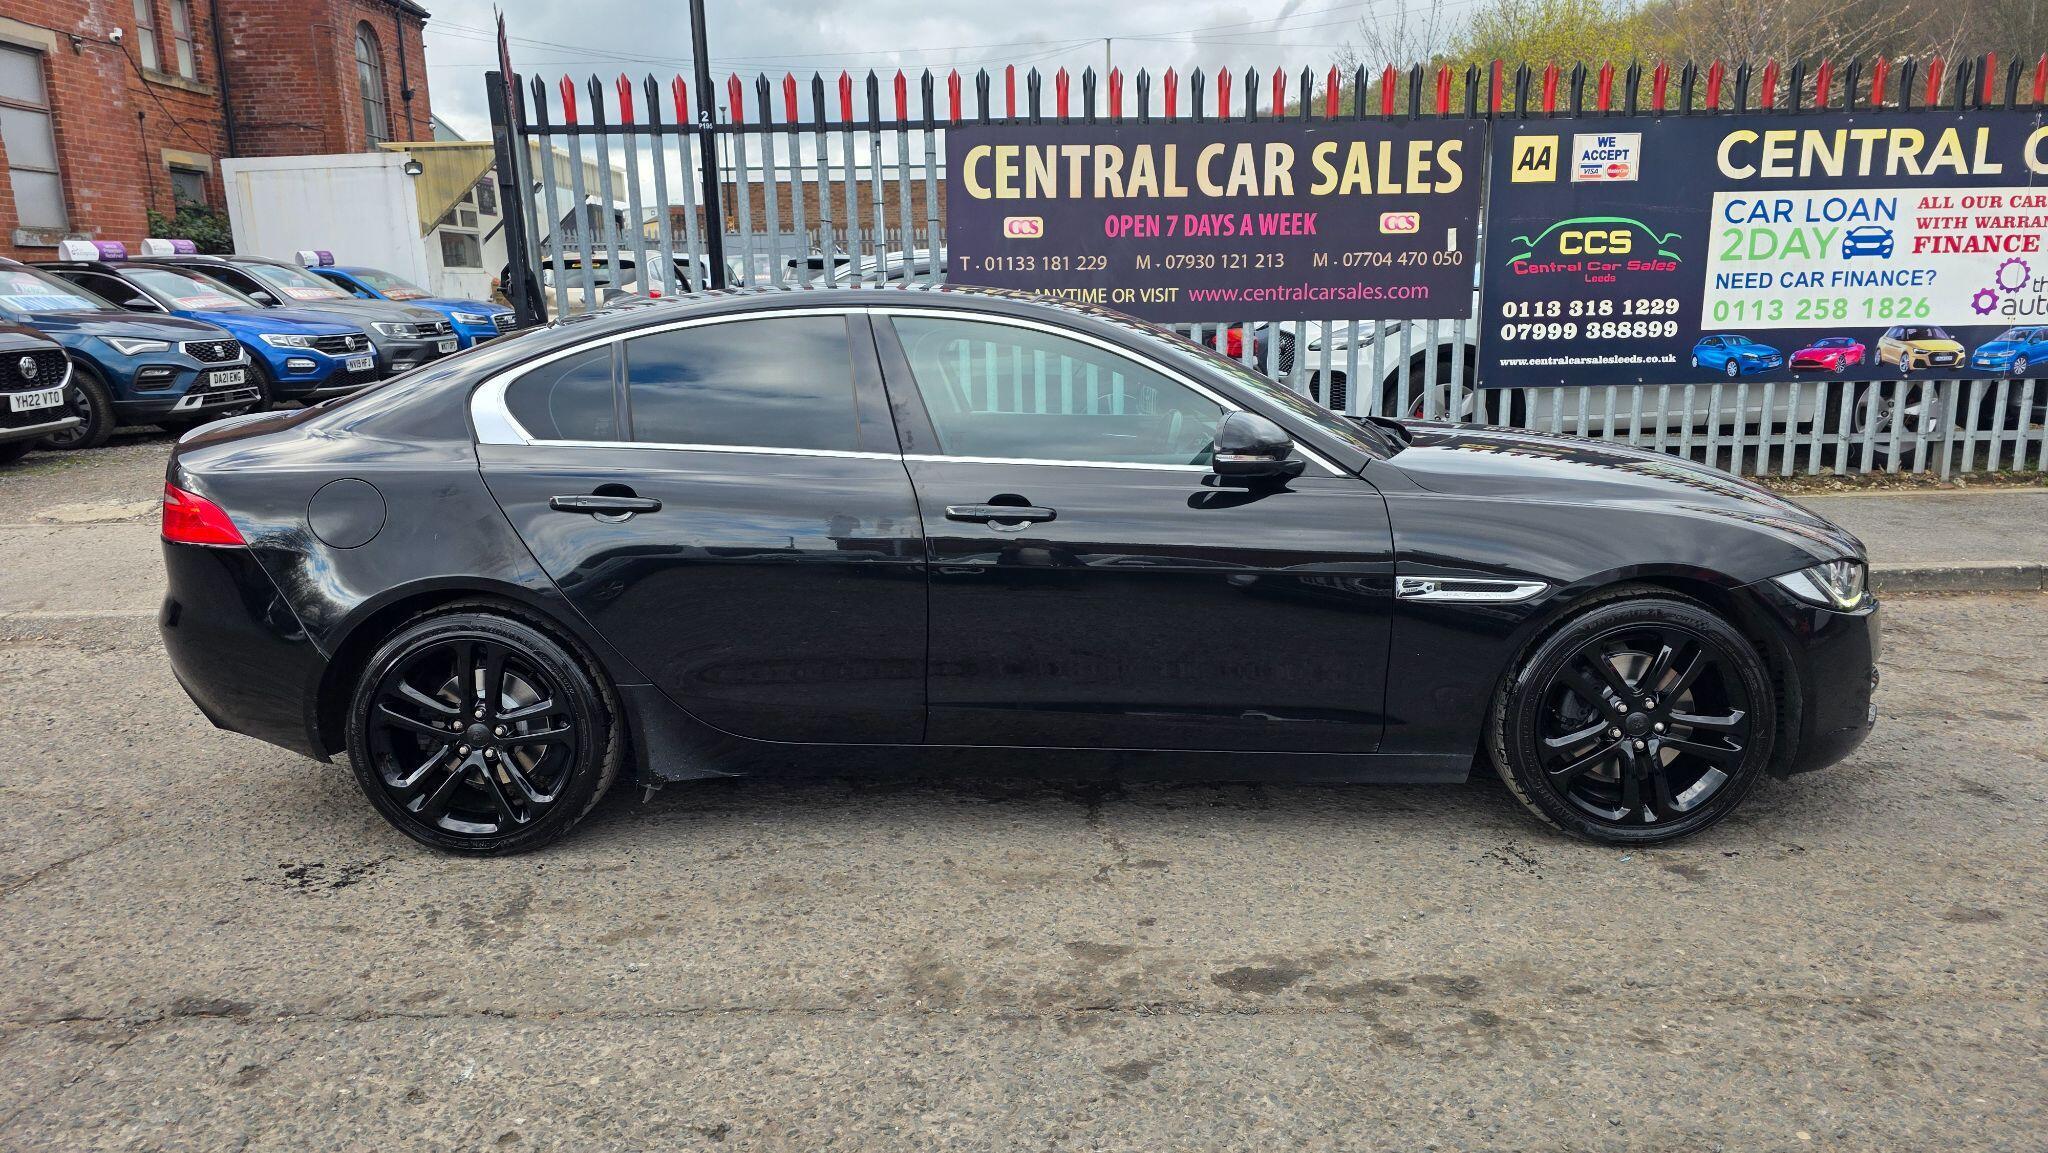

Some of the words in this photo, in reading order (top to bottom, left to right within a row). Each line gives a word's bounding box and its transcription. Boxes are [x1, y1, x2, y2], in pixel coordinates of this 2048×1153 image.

[700, 110, 710, 122] 2
[1597, 136, 1616, 148] WE
[1516, 145, 1552, 171] AA
[1581, 149, 1630, 161] ACCEPT
[1717, 126, 2003, 180] CENTRAL
[963, 144, 1188, 200] CENTRAL
[1196, 142, 1295, 198] CAR
[1310, 139, 1463, 196] SALES
[1725, 199, 1794, 224] CAR
[1805, 197, 1898, 222] LOAN
[1917, 196, 1955, 209] ALL
[1961, 195, 2003, 209] OUR
[1105, 214, 1160, 238] OPEN
[1166, 214, 1179, 238] 7
[1185, 213, 1235, 237] DAYS
[1239, 213, 1254, 236] A
[1259, 212, 1318, 236] WEEK
[1916, 216, 1968, 229] WITH
[1559, 230, 1632, 255] CCS
[1720, 227, 1840, 262] 2DAY
[1912, 234, 2041, 254] FINANCE
[960, 256, 971, 271] T
[984, 256, 1035, 271] 01133
[1043, 256, 1069, 271] 181
[1076, 255, 1108, 271] 229
[1135, 254, 1151, 270] M
[1165, 254, 1215, 269] 07930
[1222, 253, 1248, 269] 121
[1255, 253, 1285, 269] 213
[1313, 252, 1328, 268] M
[1343, 251, 1392, 267] 07704
[1397, 251, 1427, 266] 470
[1433, 250, 1463, 266] 050
[1513, 260, 1582, 275] Central
[1587, 261, 1622, 271] Car
[1627, 259, 1677, 272] Sales
[1584, 273, 1617, 283] Leeds
[1715, 272, 1773, 290] NEED
[1780, 271, 1825, 288] CAR
[1831, 269, 1937, 287] FINANCE?
[1111, 287, 1136, 303] OR
[1139, 286, 1180, 303] VISIT
[1188, 281, 1429, 303] www.centralcarsales.com
[1502, 300, 1562, 318] 0113
[1568, 299, 1613, 317] 318
[1622, 298, 1680, 316] 1229
[1713, 299, 1784, 322] 0113
[1795, 298, 1849, 320] 258
[1861, 296, 1931, 319] 1826
[2001, 294, 2048, 316] aut
[1500, 322, 1578, 341] 07999
[1585, 320, 1679, 339] 388899
[1500, 353, 1677, 367] www.centralcarsalesleeds.co.uk
[213, 372, 228, 384] DA21
[15, 394, 41, 408] YH22
